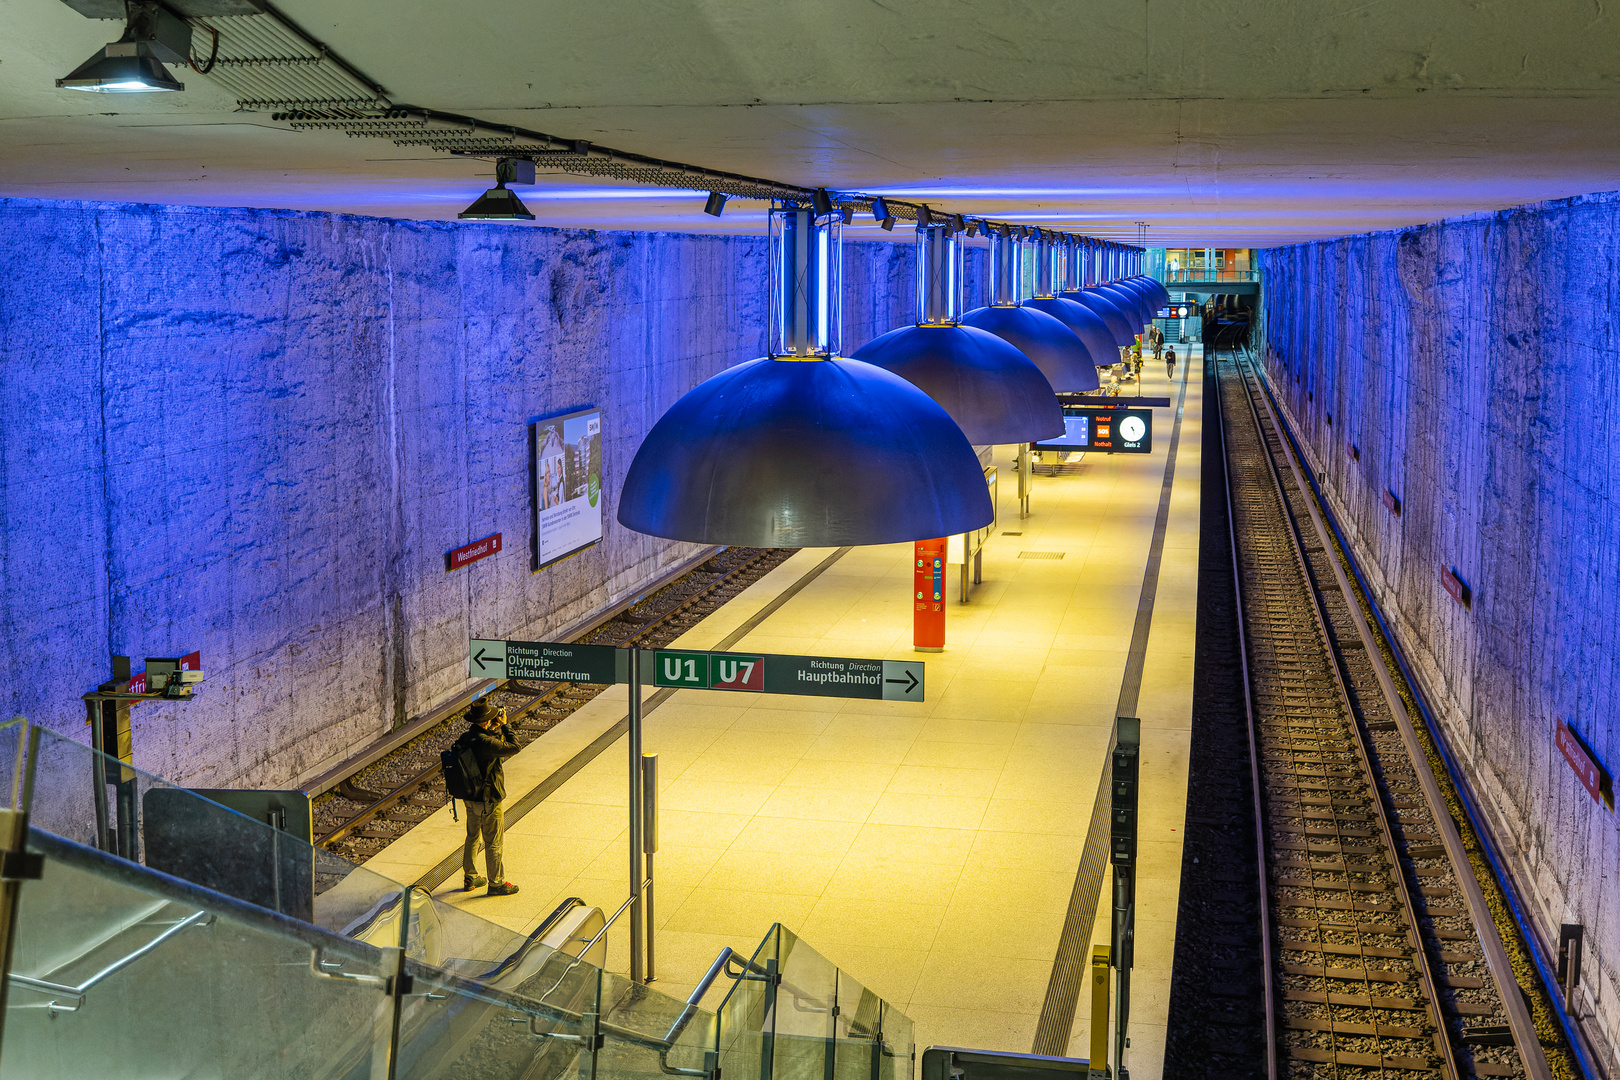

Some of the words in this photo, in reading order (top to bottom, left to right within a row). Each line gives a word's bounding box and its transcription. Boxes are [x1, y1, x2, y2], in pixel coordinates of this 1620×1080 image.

[457, 542, 488, 562] Westfriedhof
[507, 646, 539, 656] Richtung
[543, 648, 573, 657] Direction
[508, 655, 554, 668] Olympia-
[810, 660, 845, 671] Richtung
[848, 662, 881, 672] Direction
[508, 667, 590, 681] Einkaufszentrum
[664, 657, 700, 682] U1
[719, 660, 755, 685] U7
[797, 670, 881, 685] Hauptbahnhof
